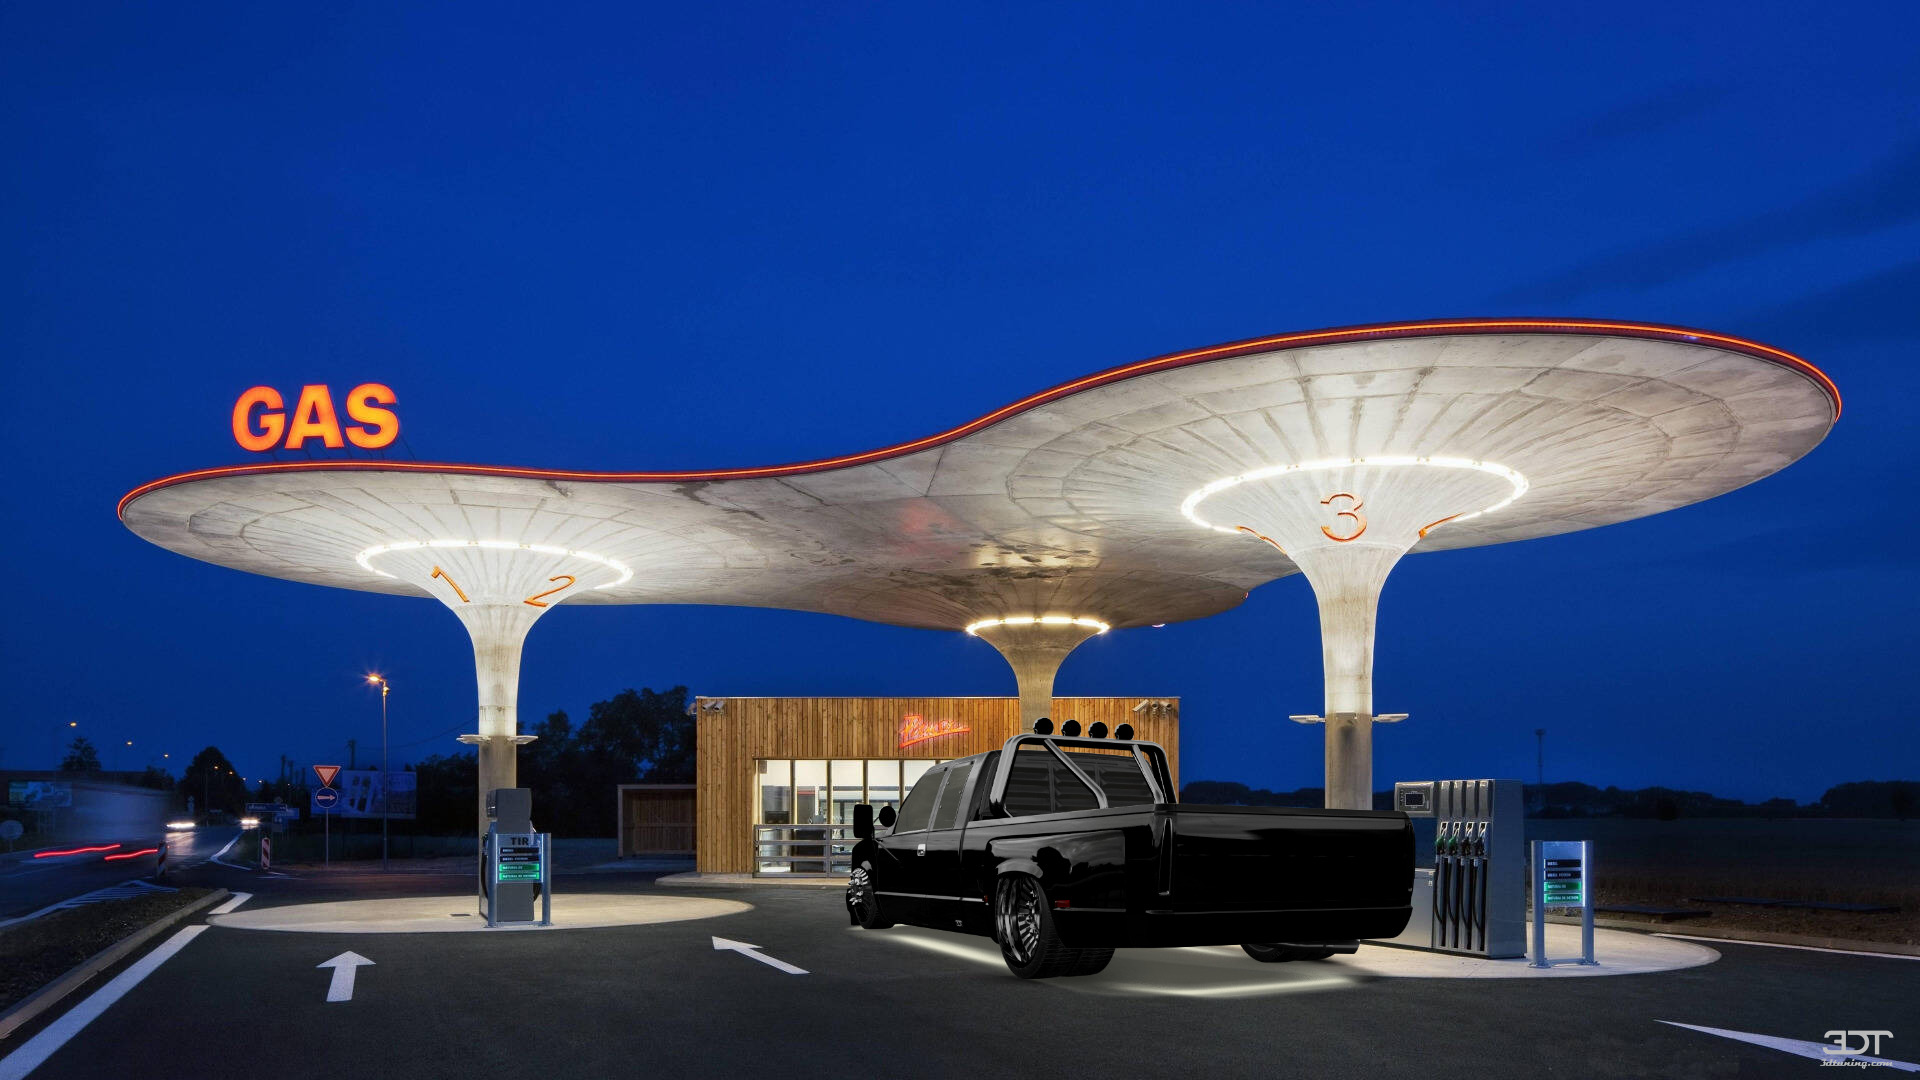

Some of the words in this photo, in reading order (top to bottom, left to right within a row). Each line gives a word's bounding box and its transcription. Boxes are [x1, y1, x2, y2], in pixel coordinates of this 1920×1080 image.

[232, 382, 399, 452] GAS
[1320, 493, 1368, 542] 3
[431, 565, 470, 603] 1
[523, 575, 576, 608] 2
[511, 837, 529, 846] TIR
